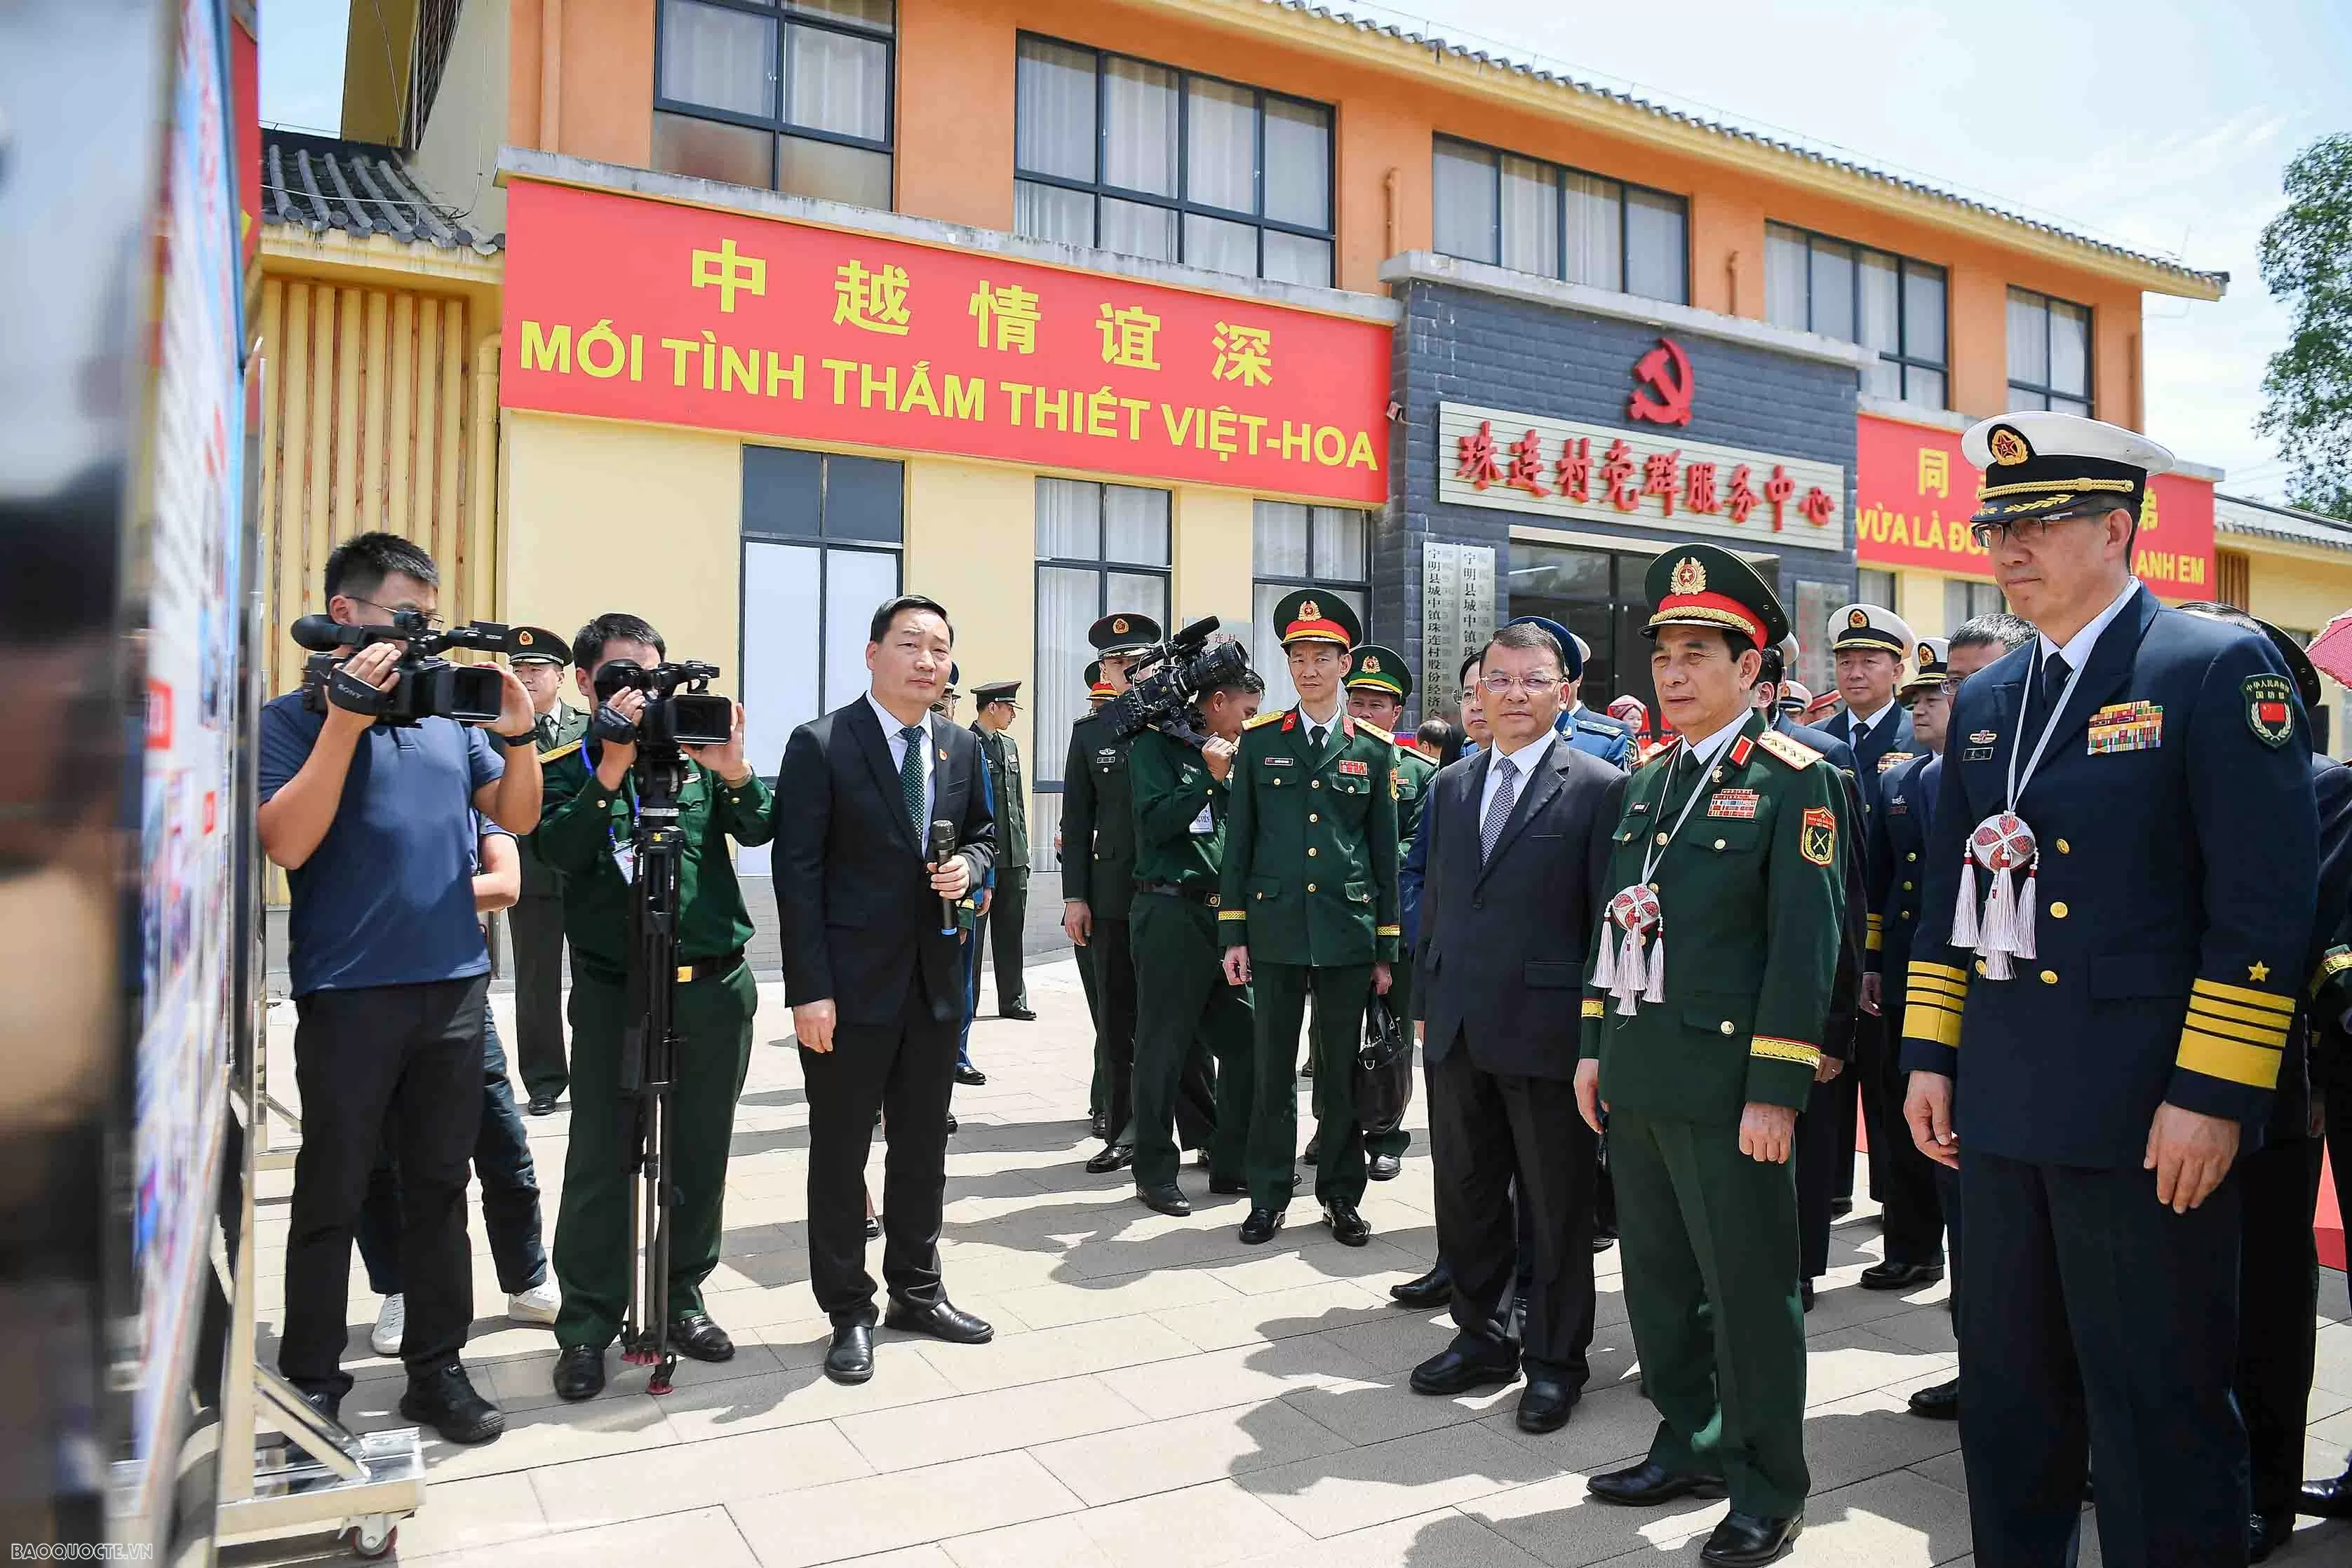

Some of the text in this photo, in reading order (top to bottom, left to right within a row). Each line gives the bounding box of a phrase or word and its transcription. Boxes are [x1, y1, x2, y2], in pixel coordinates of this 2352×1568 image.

[691, 238, 1273, 387] 中越情谊深
[520, 318, 1378, 471] MỐI TÌNH THẮM THIẾT VIỆT-HOA
[1855, 502, 1909, 546] VỪA
[1913, 511, 1945, 550] LÀ
[2136, 549, 2205, 585] ANH EM
